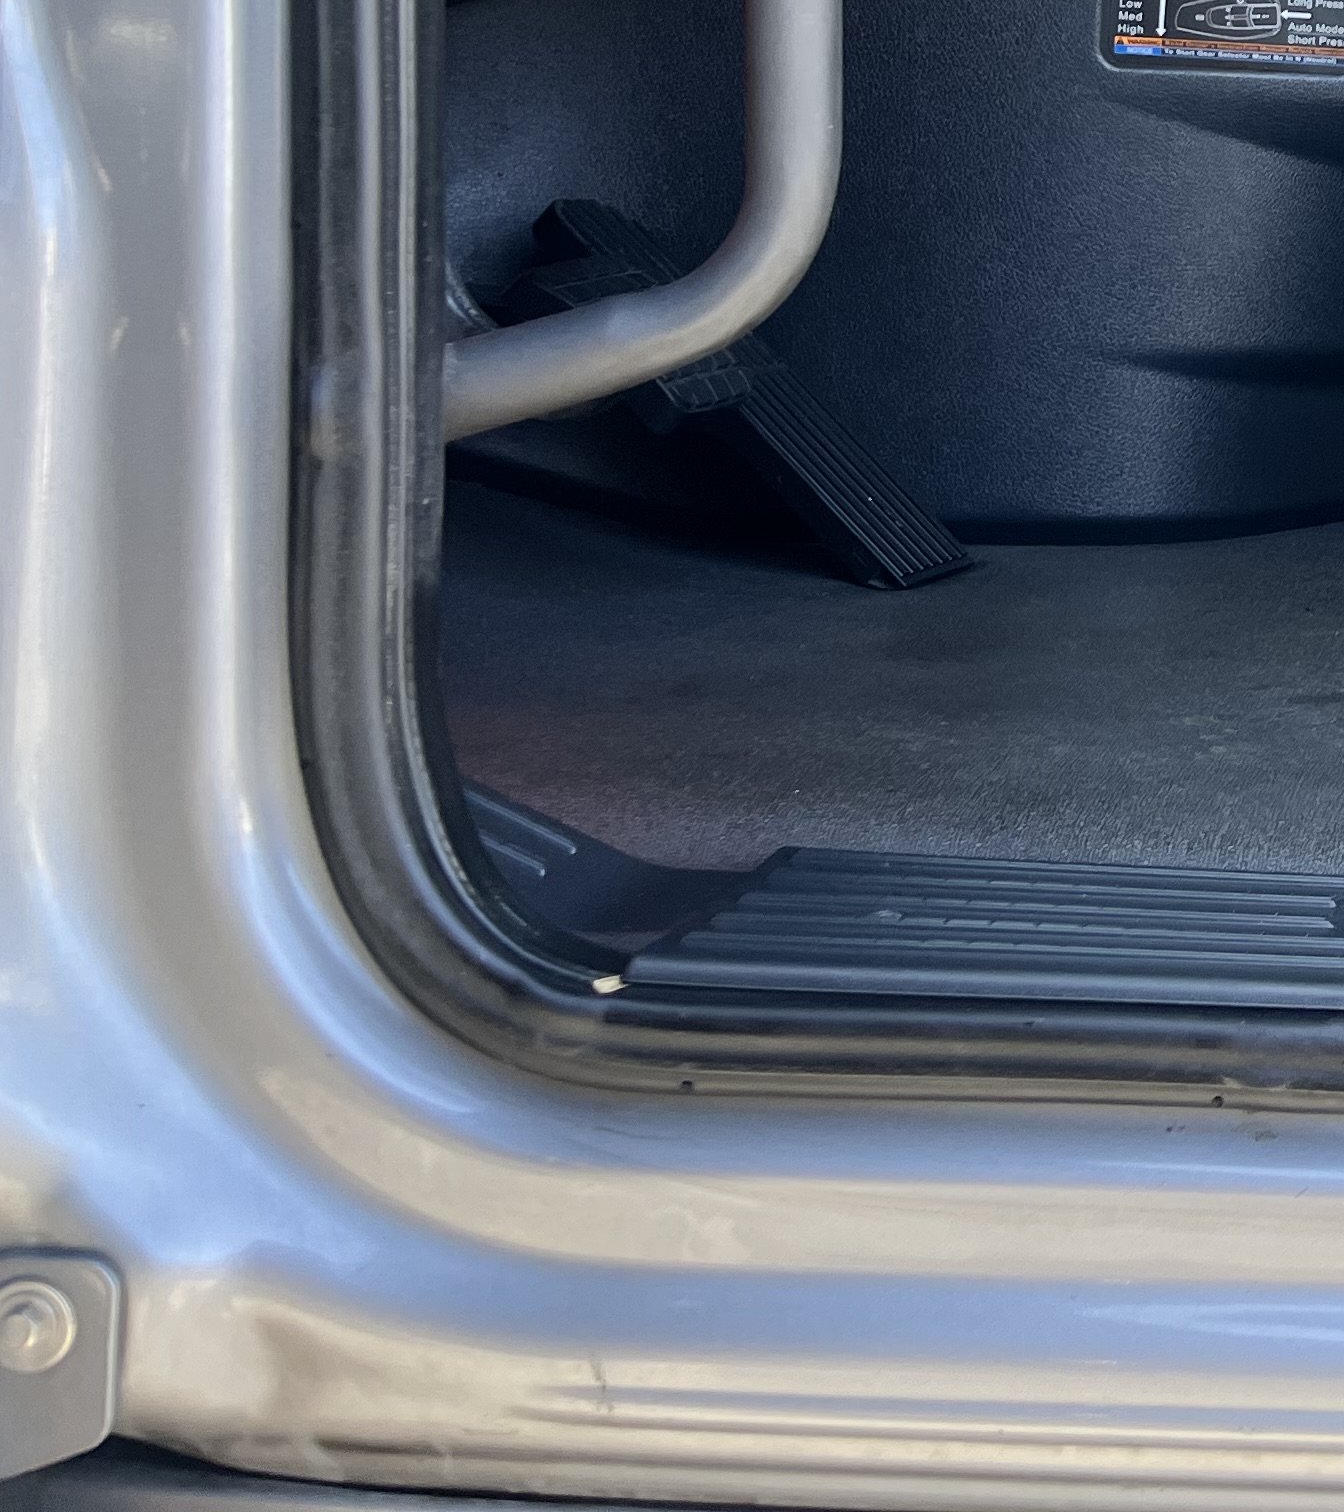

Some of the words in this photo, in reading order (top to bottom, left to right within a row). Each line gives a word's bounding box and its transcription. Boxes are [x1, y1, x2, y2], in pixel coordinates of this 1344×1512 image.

[1118, 11, 1143, 22] Med
[1117, 24, 1144, 36] High
[1287, 22, 1312, 33] Auto
[1315, 23, 1344, 35] Mode
[1287, 34, 1316, 45] Short
